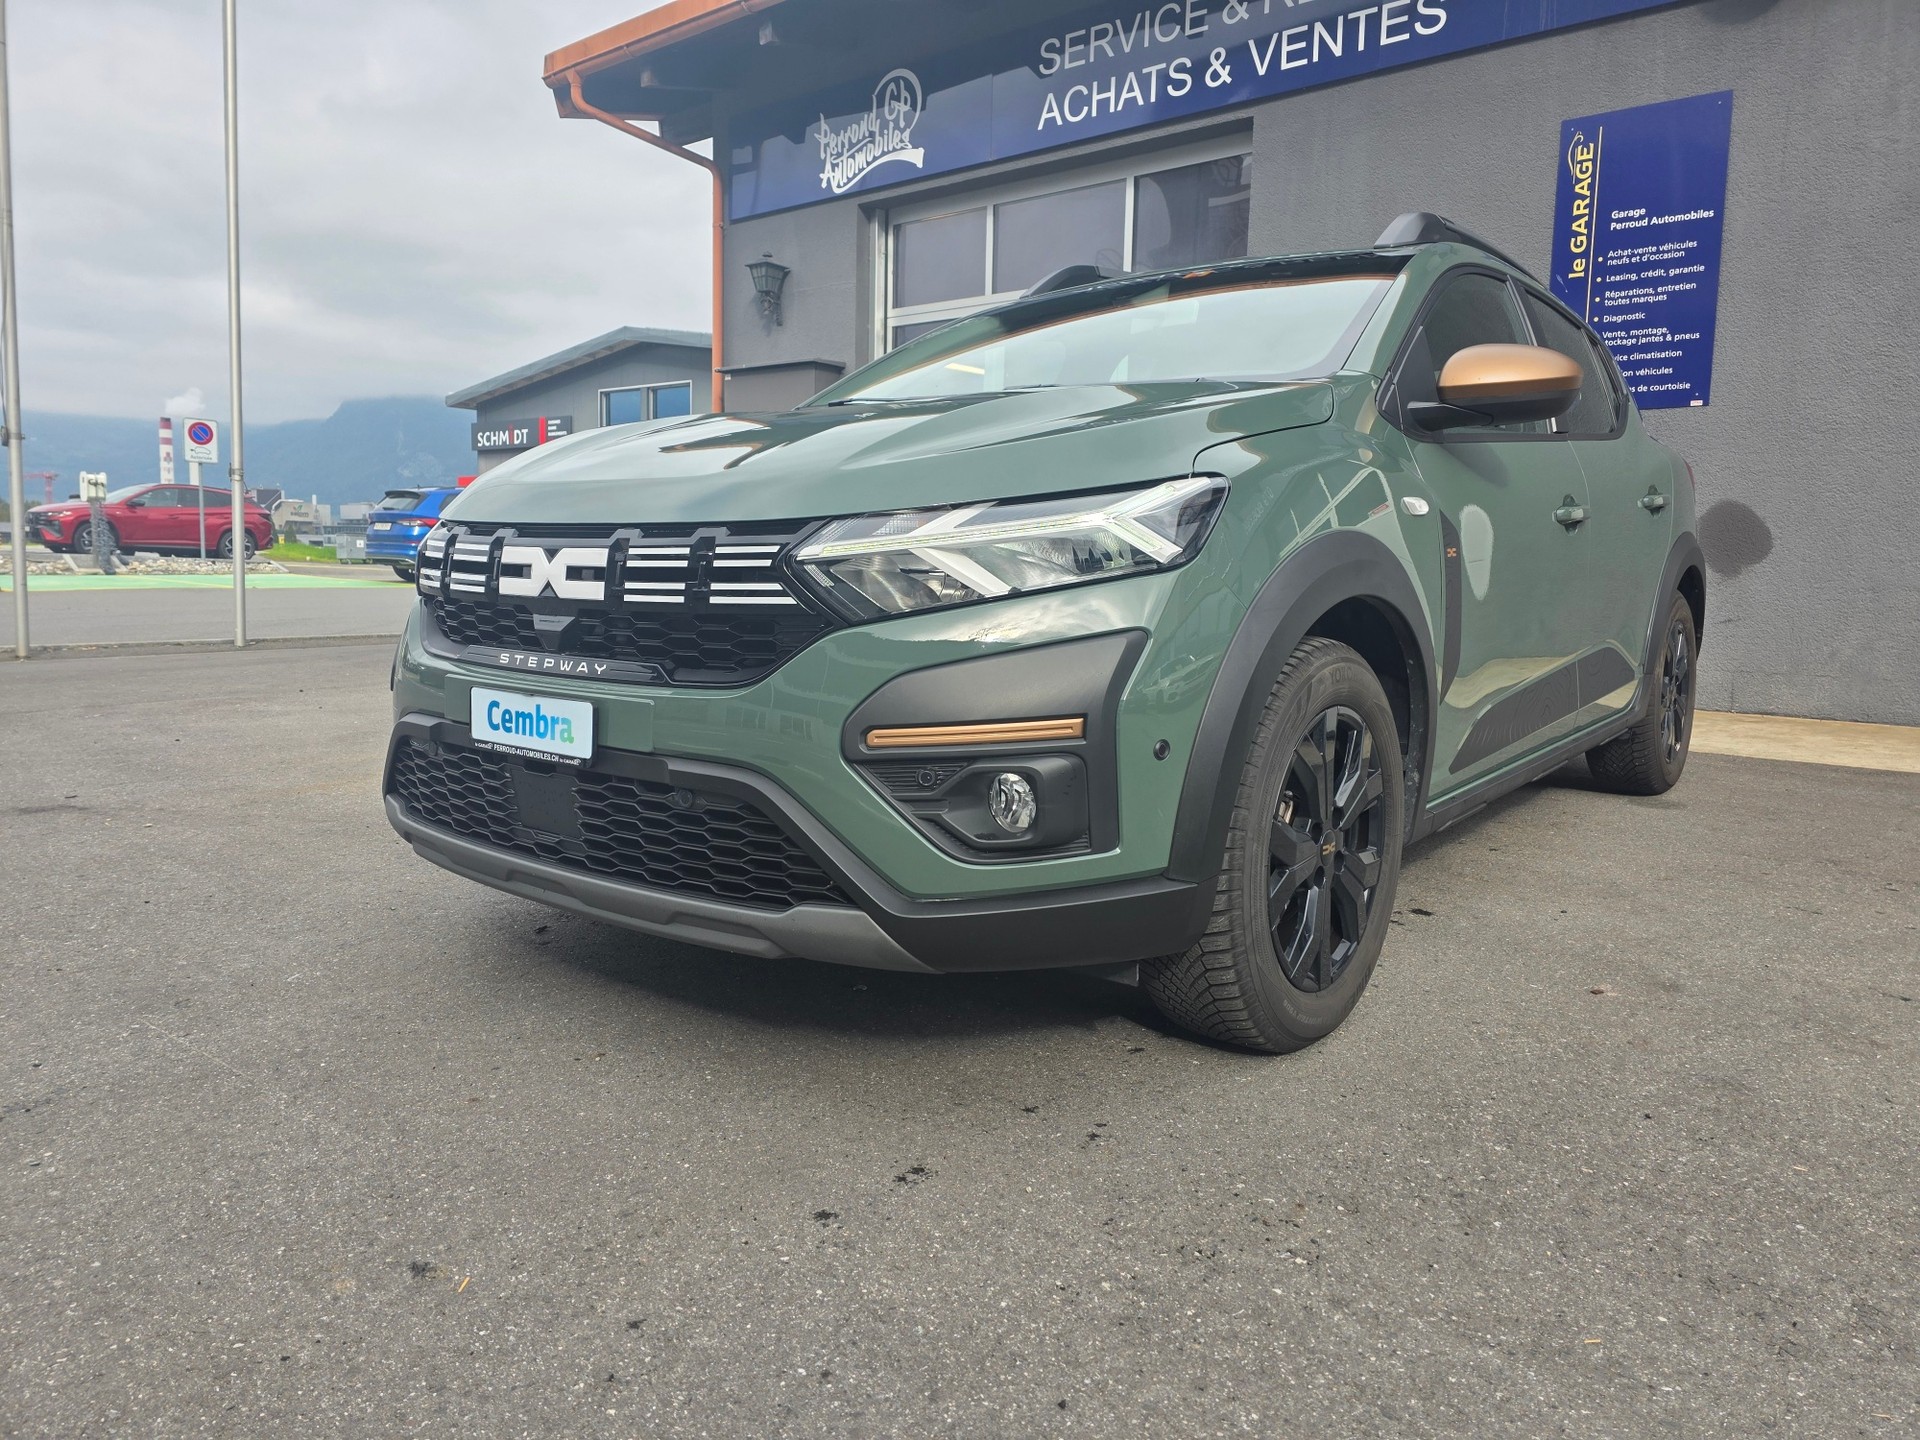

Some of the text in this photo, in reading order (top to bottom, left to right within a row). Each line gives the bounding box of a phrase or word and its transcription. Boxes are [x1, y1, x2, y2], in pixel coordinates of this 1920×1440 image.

[1038, 0, 1250, 75] SERVICE &
[1037, 0, 1448, 130] ACHATS & VENTES
[1568, 142, 1594, 279] le GARAGE
[1611, 208, 1646, 219] Garage
[1610, 209, 1715, 231] Perroud Automobiles
[1607, 240, 1698, 258] Achat-vente véhicules
[1607, 256, 1630, 266] neufs
[1642, 250, 1685, 262] d'occasion
[1606, 264, 1705, 282] Leasing, crédit, garantie
[1605, 282, 1697, 299] Réparations, entretien
[1604, 294, 1667, 307] toutes marques
[1603, 312, 1646, 323] Diagnostic
[1604, 332, 1700, 347] tockage jantes & pneus
[1630, 327, 1669, 336] montage,
[1630, 350, 1683, 361] climatisation
[1635, 367, 1673, 377] véhicules
[1637, 384, 1648, 393] de
[1649, 381, 1691, 392] courtoisie
[499, 653, 607, 675] STEPWAY
[487, 700, 575, 744] Cembra
